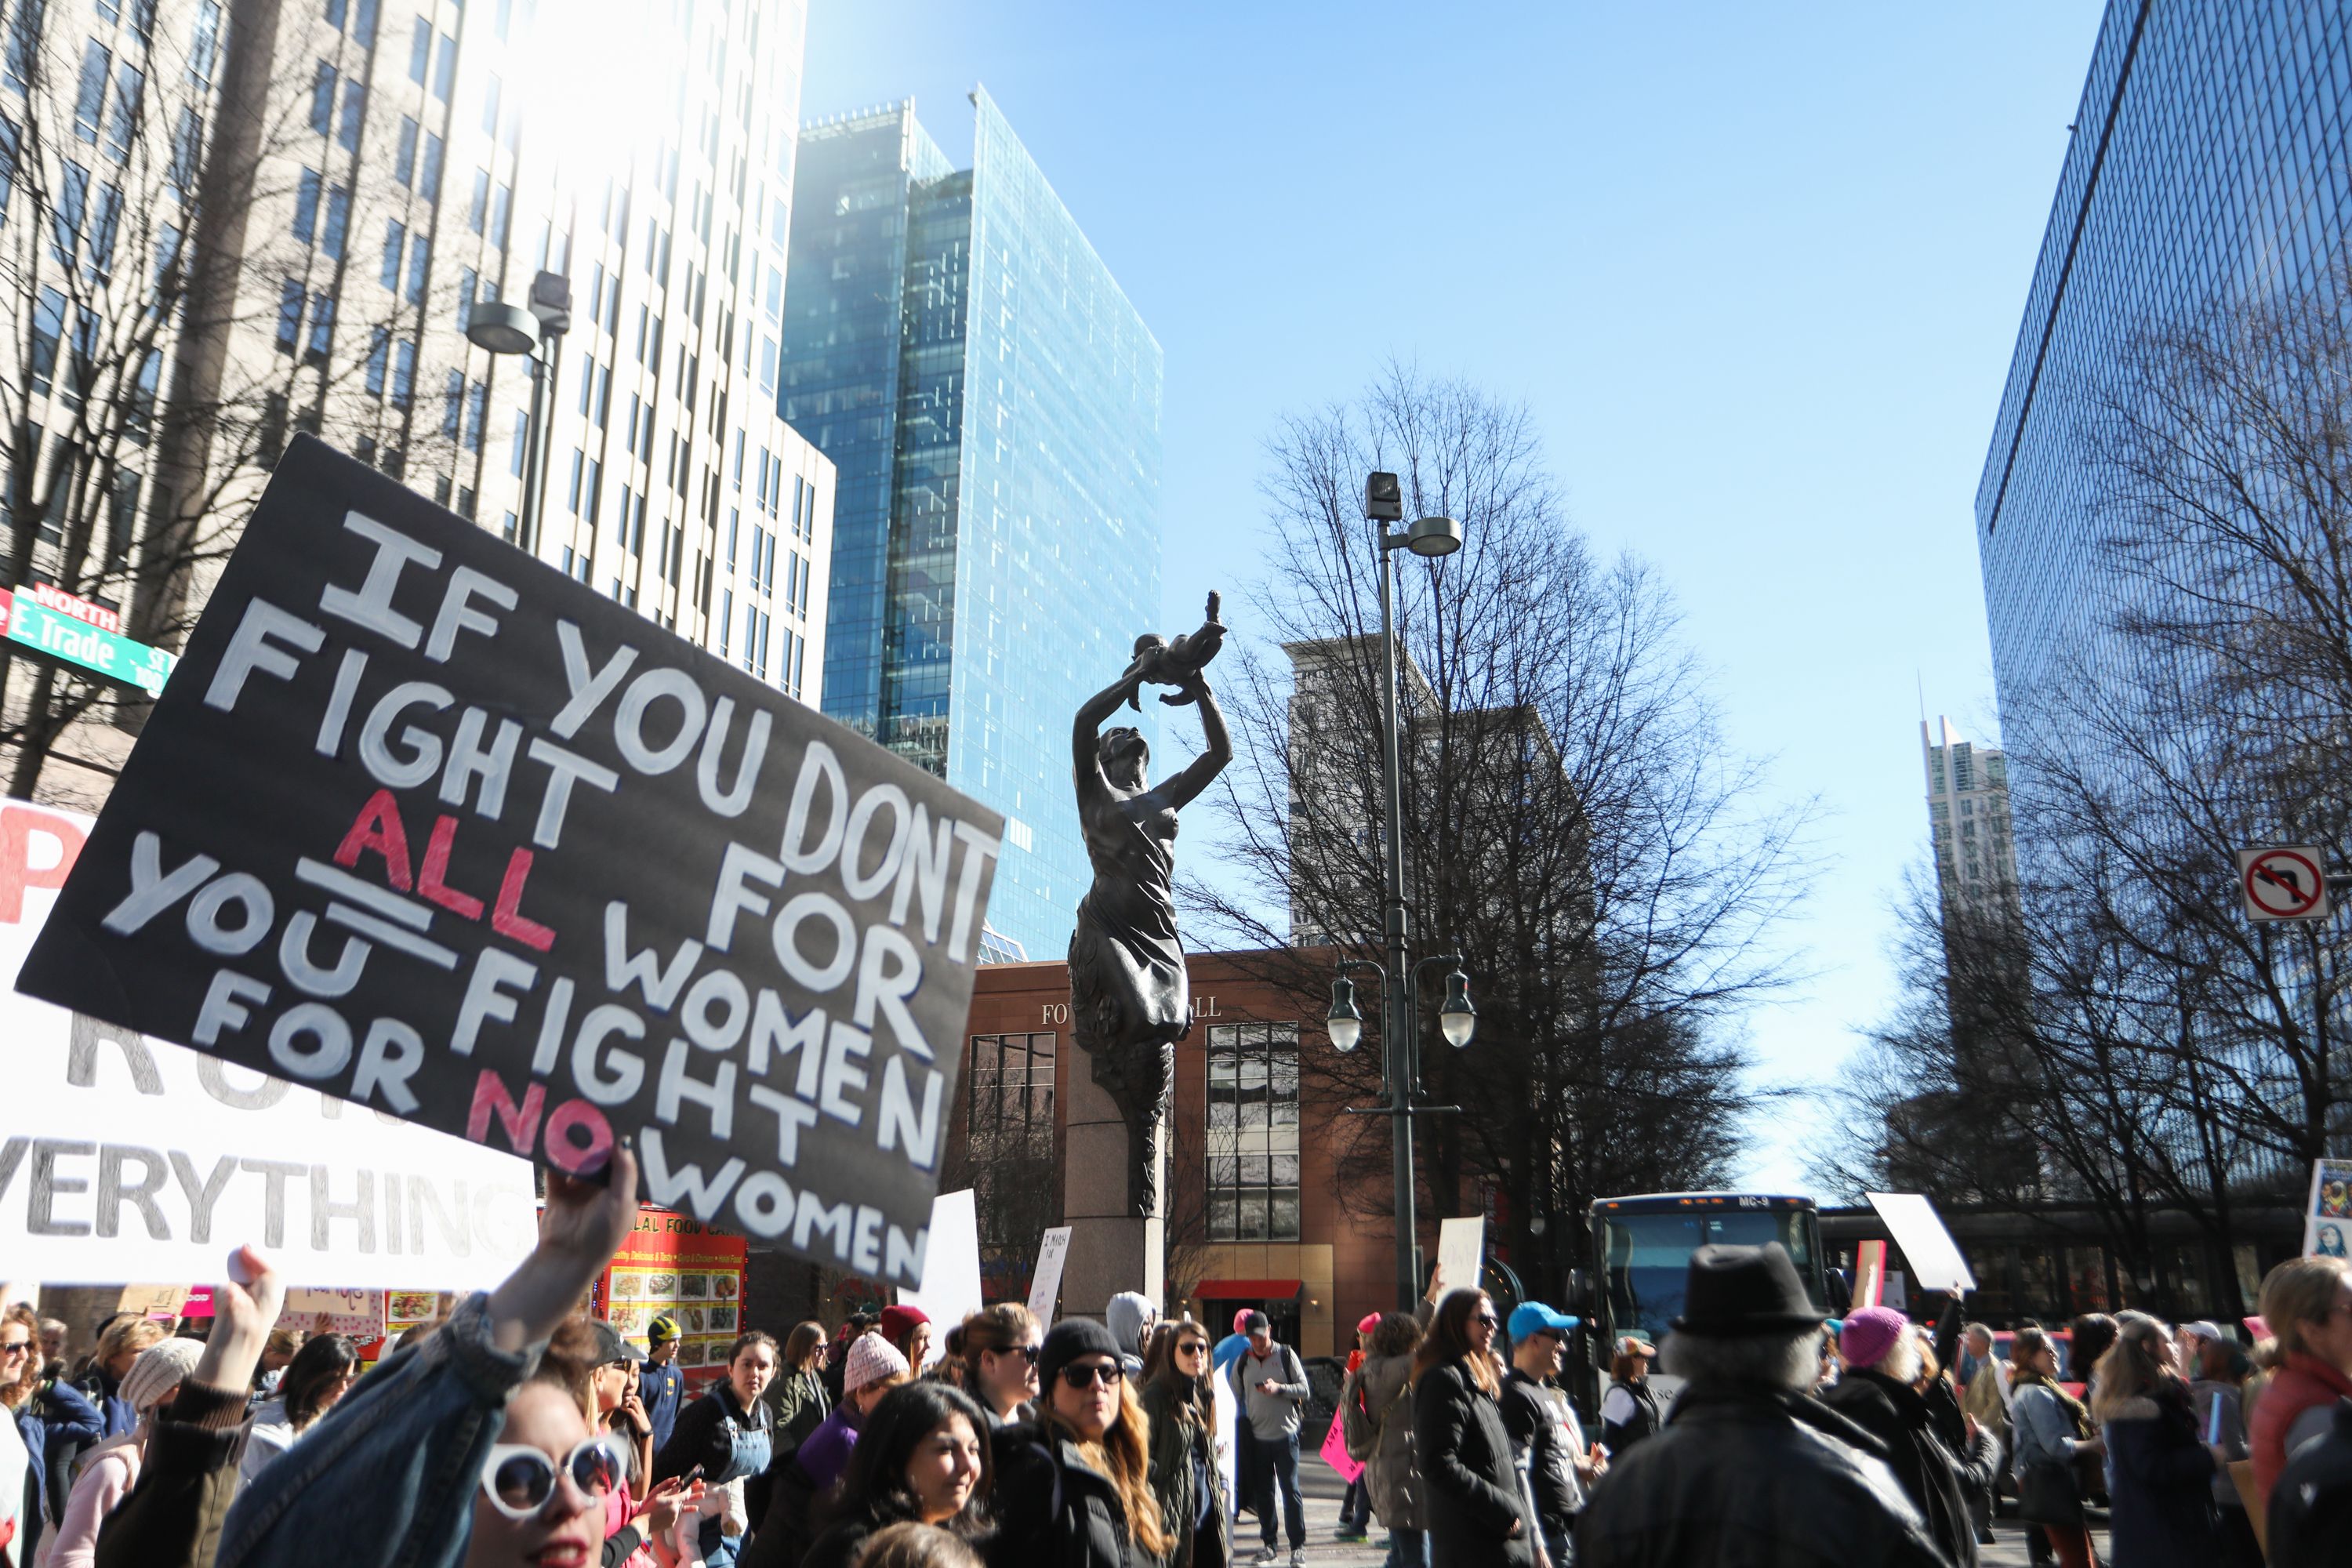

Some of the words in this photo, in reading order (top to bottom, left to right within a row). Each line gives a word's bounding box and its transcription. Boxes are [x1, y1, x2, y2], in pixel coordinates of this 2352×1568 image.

[11, 601, 34, 639] E.
[41, 614, 115, 670] Trade
[37, 583, 117, 631] NORTH
[318, 509, 519, 663] IF
[550, 620, 771, 818] YOU
[780, 740, 1002, 964] DONT
[203, 597, 619, 849] FIGHT
[707, 841, 933, 1062] FOR
[100, 830, 372, 996] YOU
[450, 946, 817, 1165] FIGHT
[334, 789, 556, 951] ALL
[605, 901, 943, 1171] WOMEN
[192, 968, 426, 1114] FOR
[467, 1068, 615, 1176] NO
[641, 1126, 930, 1279] WOMEN
[632, 1216, 660, 1232] LAL
[666, 1218, 703, 1236] FOOD
[1738, 1196, 1770, 1208] MC-9
[613, 1250, 630, 1263] ealthy
[1051, 1233, 1067, 1247] MARCH
